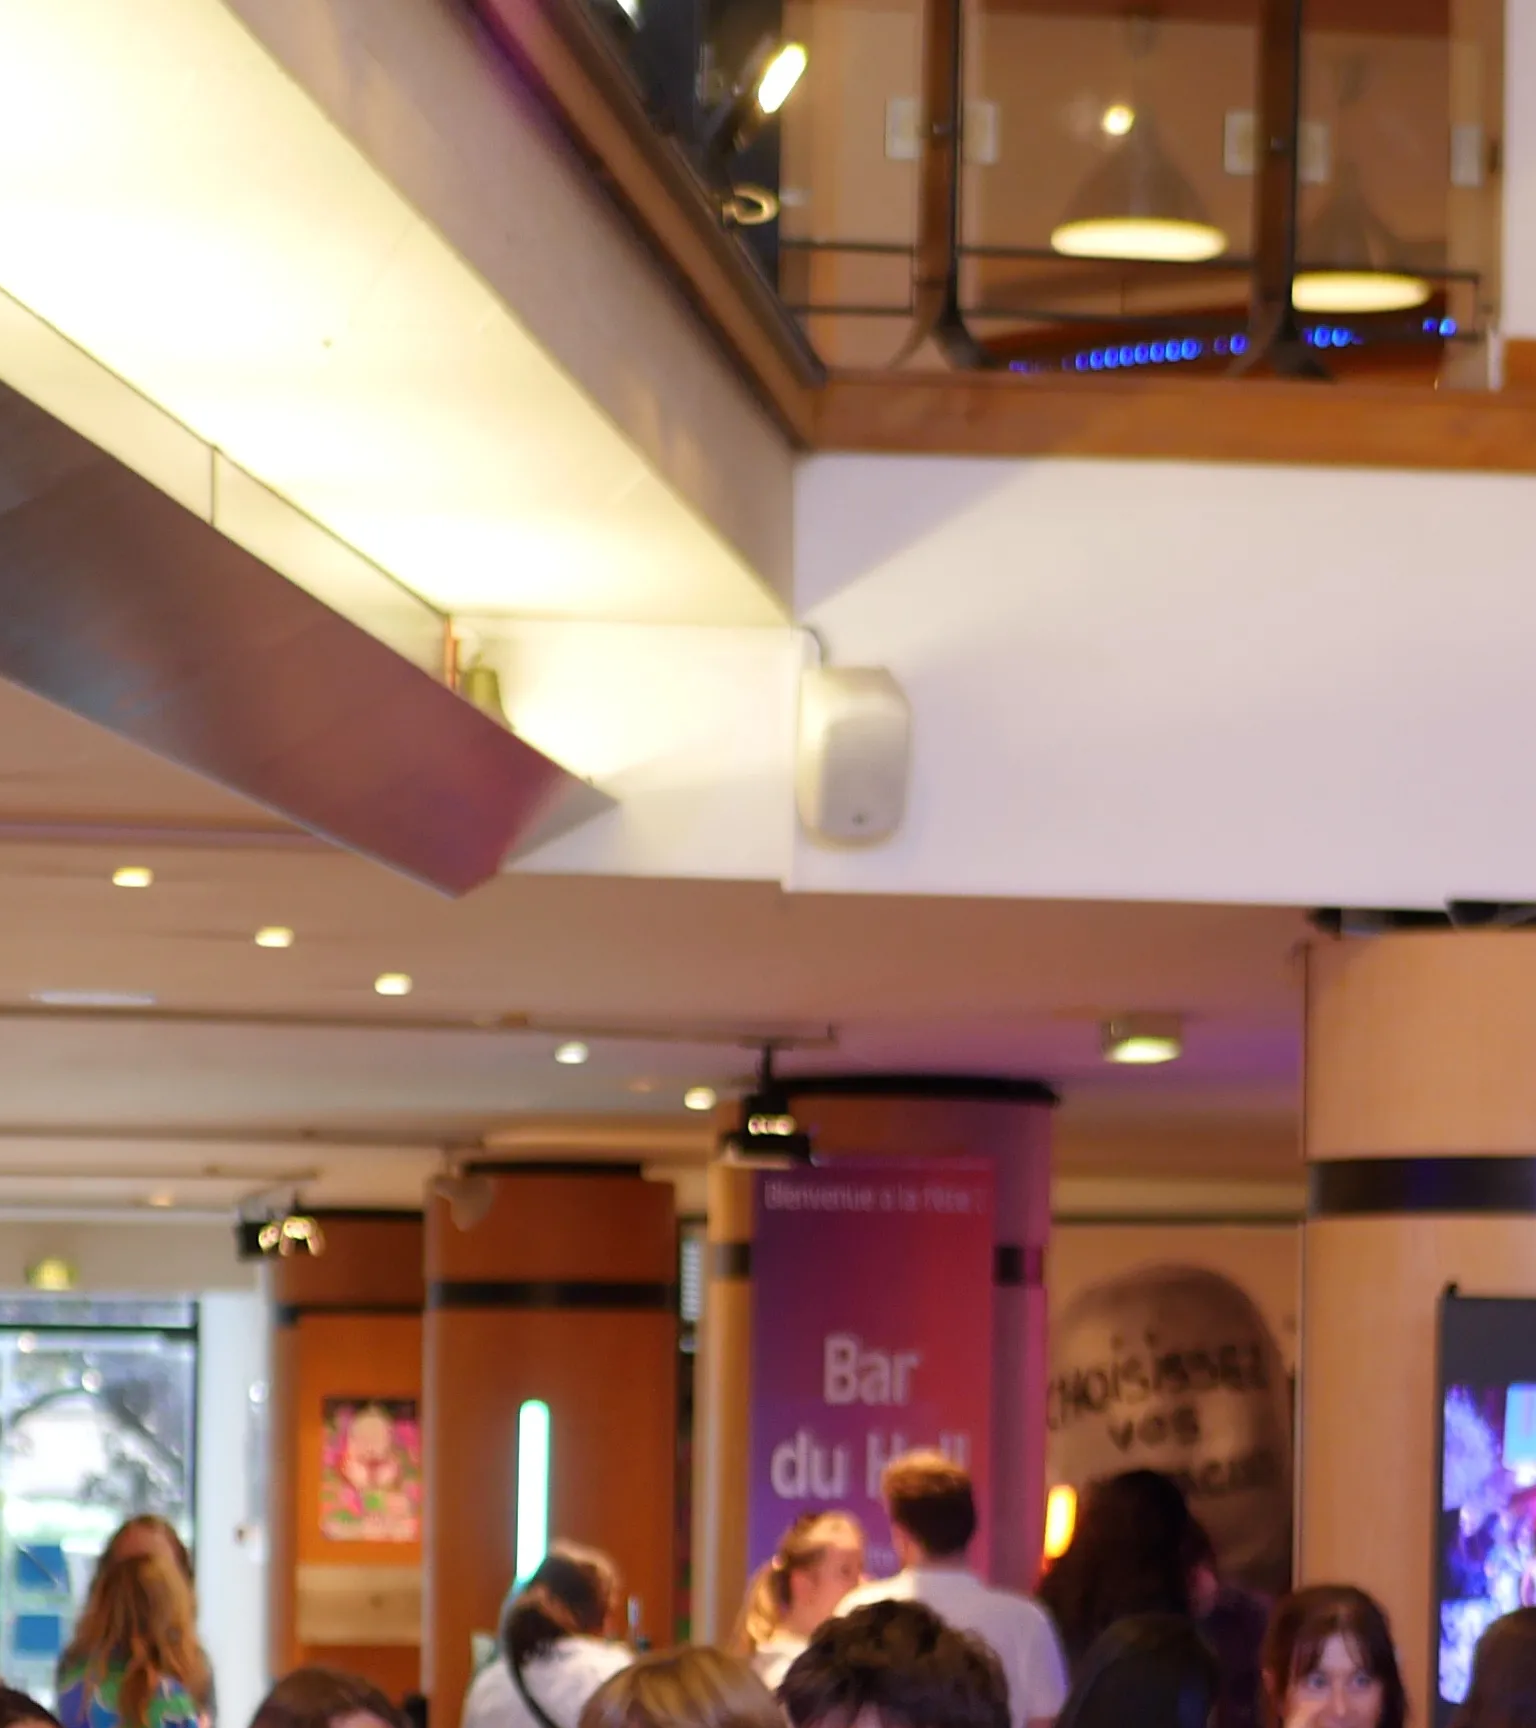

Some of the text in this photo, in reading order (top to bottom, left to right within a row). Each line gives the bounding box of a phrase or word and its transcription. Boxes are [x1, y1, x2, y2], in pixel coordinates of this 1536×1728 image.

[897, 1181, 918, 1213] la
[822, 1333, 921, 1406] Bar
[769, 1427, 971, 1500] du Hll
